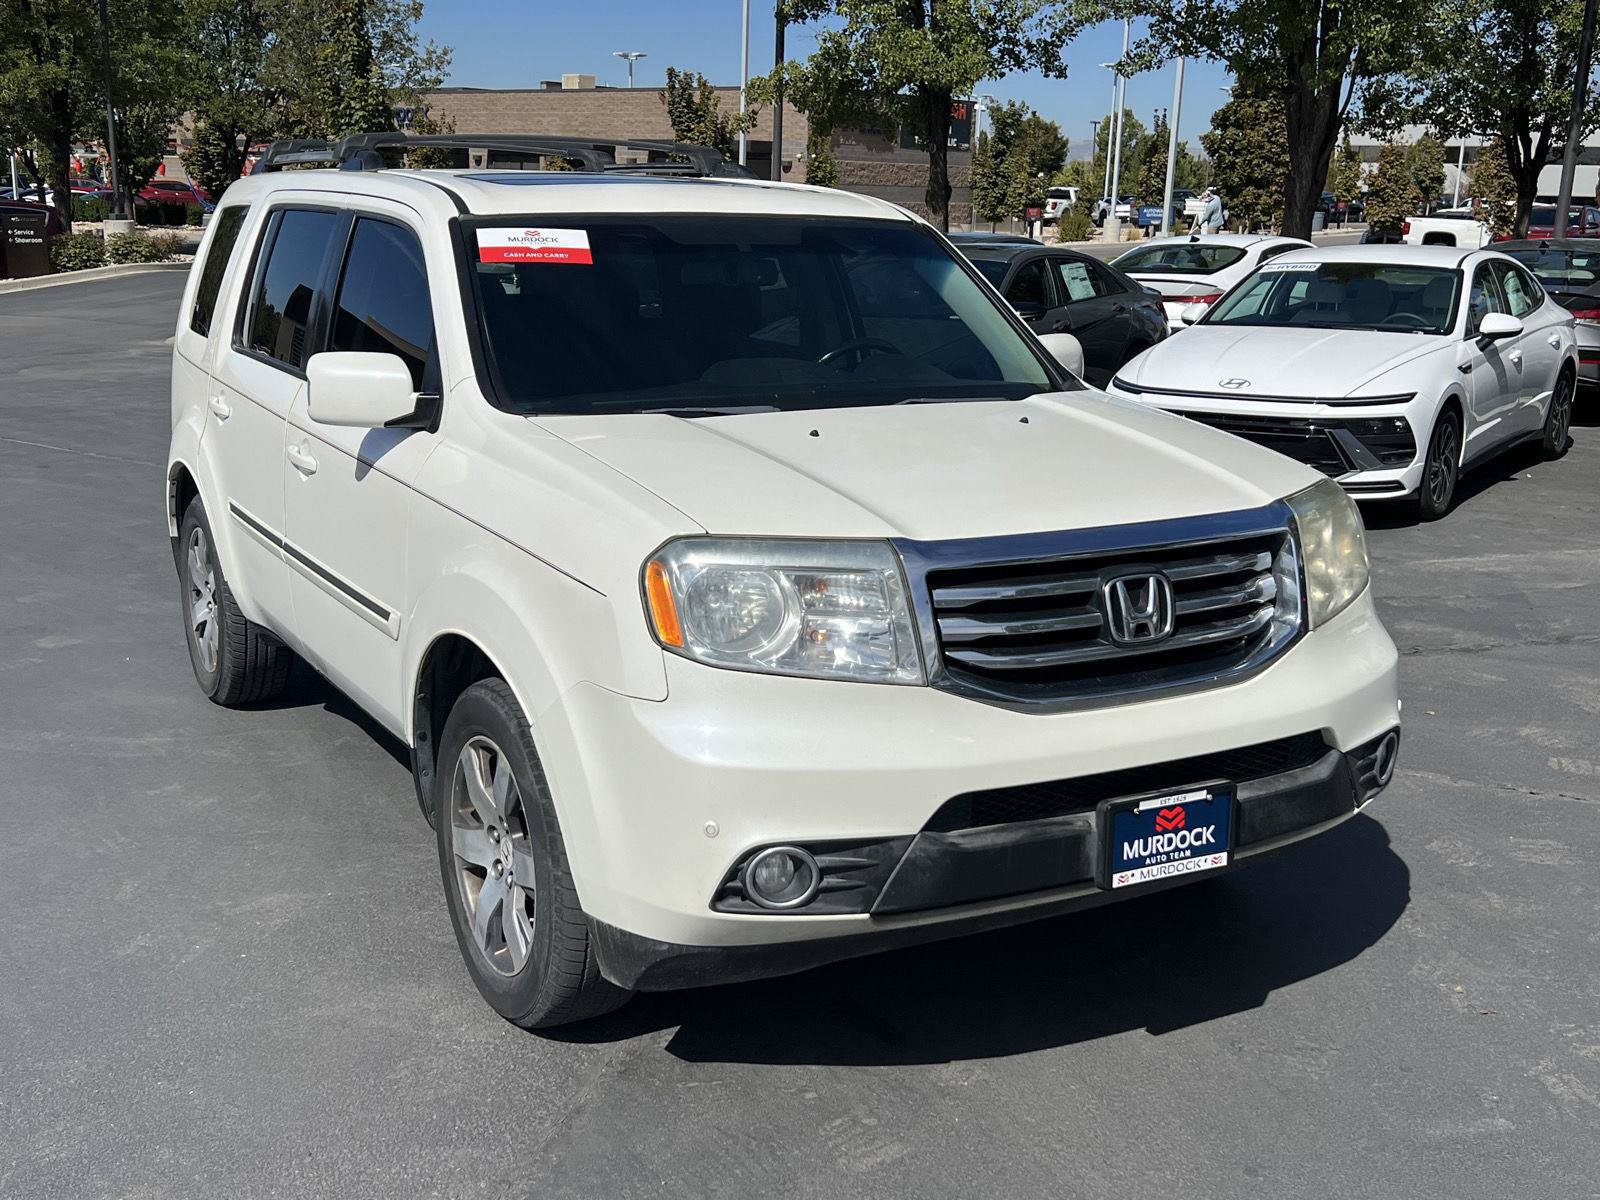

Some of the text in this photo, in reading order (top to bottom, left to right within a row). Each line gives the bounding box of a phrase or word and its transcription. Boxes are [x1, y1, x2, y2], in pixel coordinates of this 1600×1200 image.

[1123, 825, 1215, 860] MURDOCK
[1145, 849, 1192, 866] AUTO TEAM
[1140, 858, 1202, 880] MURDOCK
